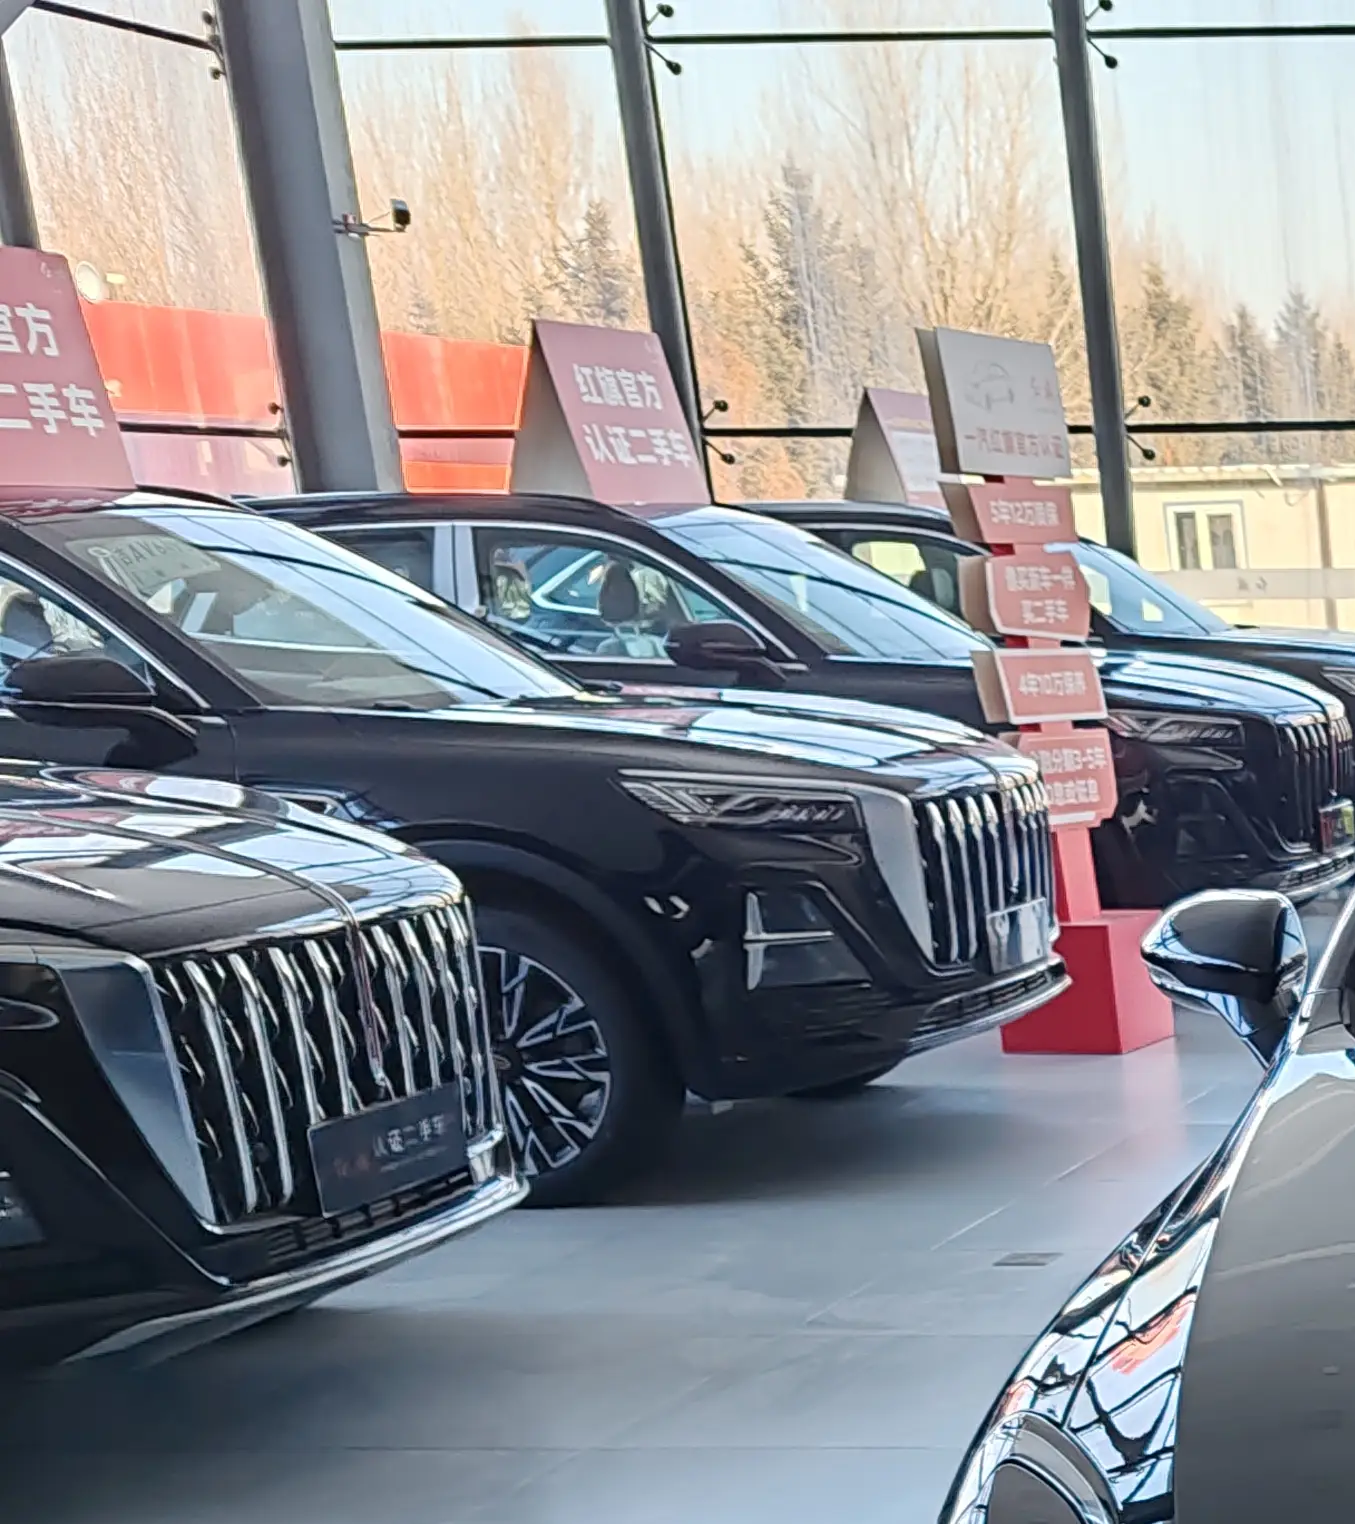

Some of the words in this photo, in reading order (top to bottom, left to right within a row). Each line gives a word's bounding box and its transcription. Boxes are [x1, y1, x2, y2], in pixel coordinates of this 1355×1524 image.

[573, 363, 663, 410] 红旗官方
[582, 423, 692, 467] 认证二手车
